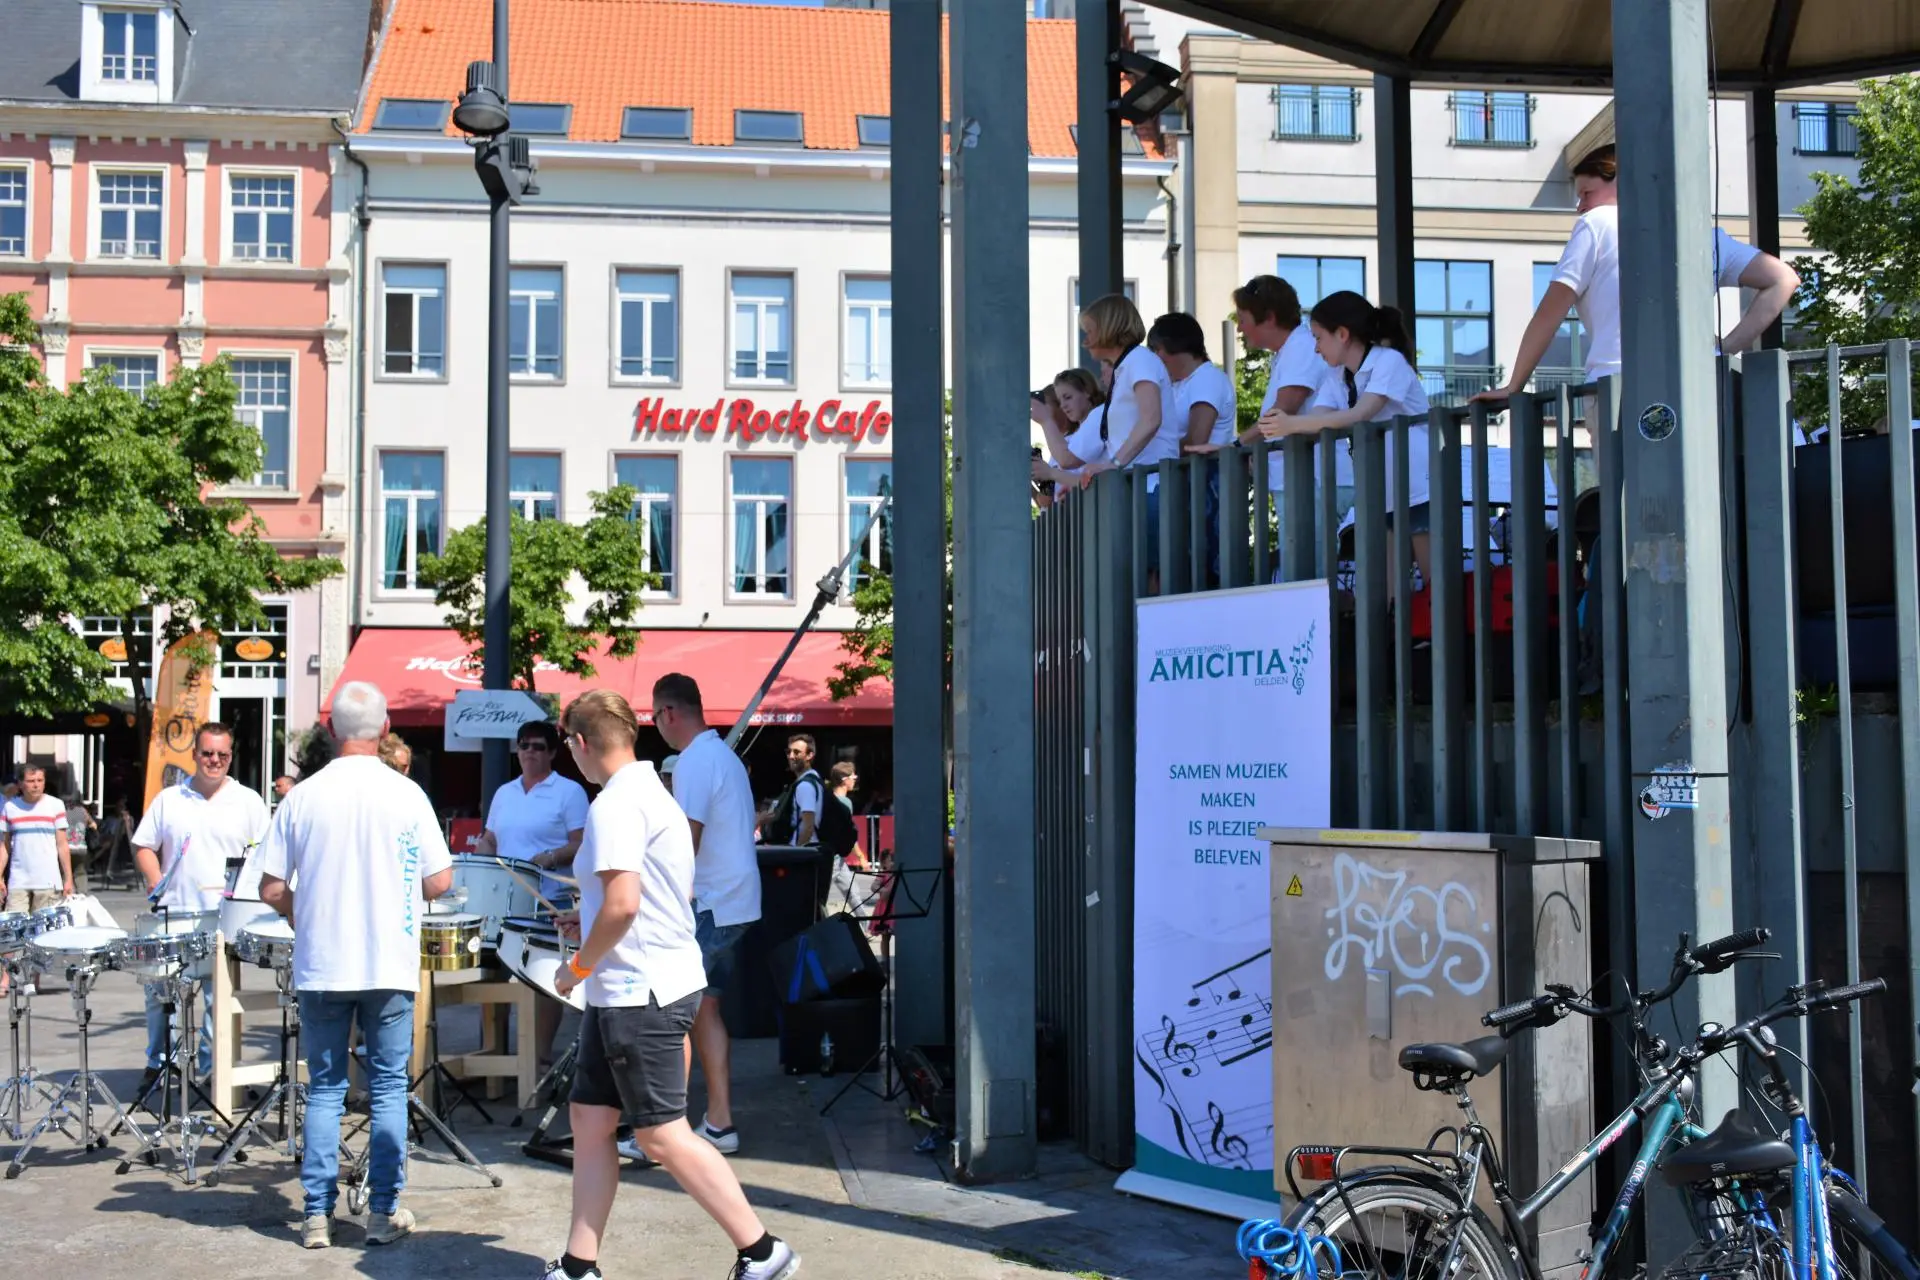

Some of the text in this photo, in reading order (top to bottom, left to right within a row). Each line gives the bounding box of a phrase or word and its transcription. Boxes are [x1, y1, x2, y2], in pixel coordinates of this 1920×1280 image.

[632, 397, 892, 442] Hard Rock Cafe
[1154, 643, 1232, 657] MUZIEKVERENIGING
[1149, 648, 1288, 682] AMICITIA
[1254, 676, 1289, 687] DELDEN
[456, 707, 527, 724] FESTIVAL
[777, 712, 804, 723] SHOP
[1169, 762, 1288, 779] SAMEN MUZIEK
[1200, 792, 1255, 807] MAKEN
[1189, 820, 1203, 835] IS
[1194, 848, 1261, 865] BELEVEN
[1300, 1146, 1331, 1154] OXFORD
